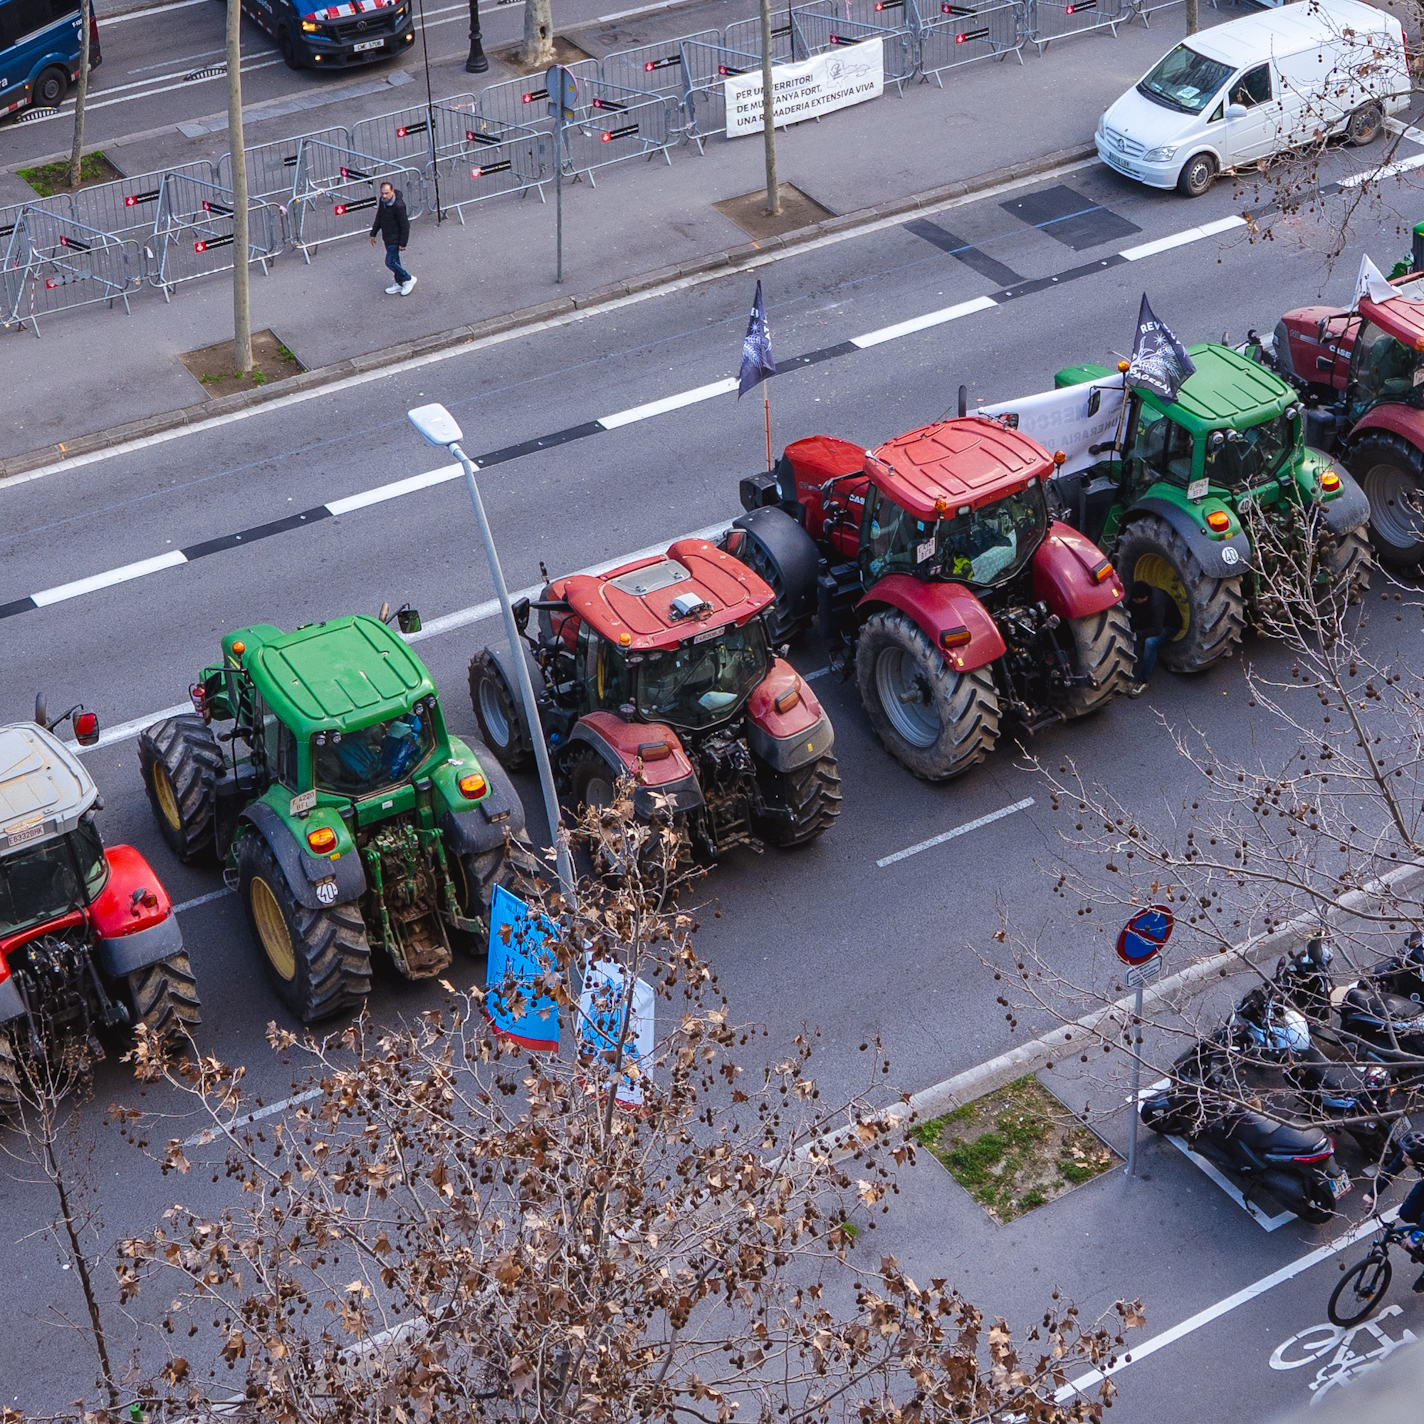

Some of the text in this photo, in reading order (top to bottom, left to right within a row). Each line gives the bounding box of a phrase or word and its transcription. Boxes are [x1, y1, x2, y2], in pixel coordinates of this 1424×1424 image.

[736, 89, 752, 100] PER
[736, 104, 749, 113] DE
[750, 91, 799, 110] MUTANYA
[737, 81, 875, 126] UNA RMADERIA EXTENSIVA VIVA
[1329, 345, 1352, 358] CASE
[849, 494, 866, 505] CAS
[1225, 547, 1237, 563] 40
[317, 883, 336, 901] 40
